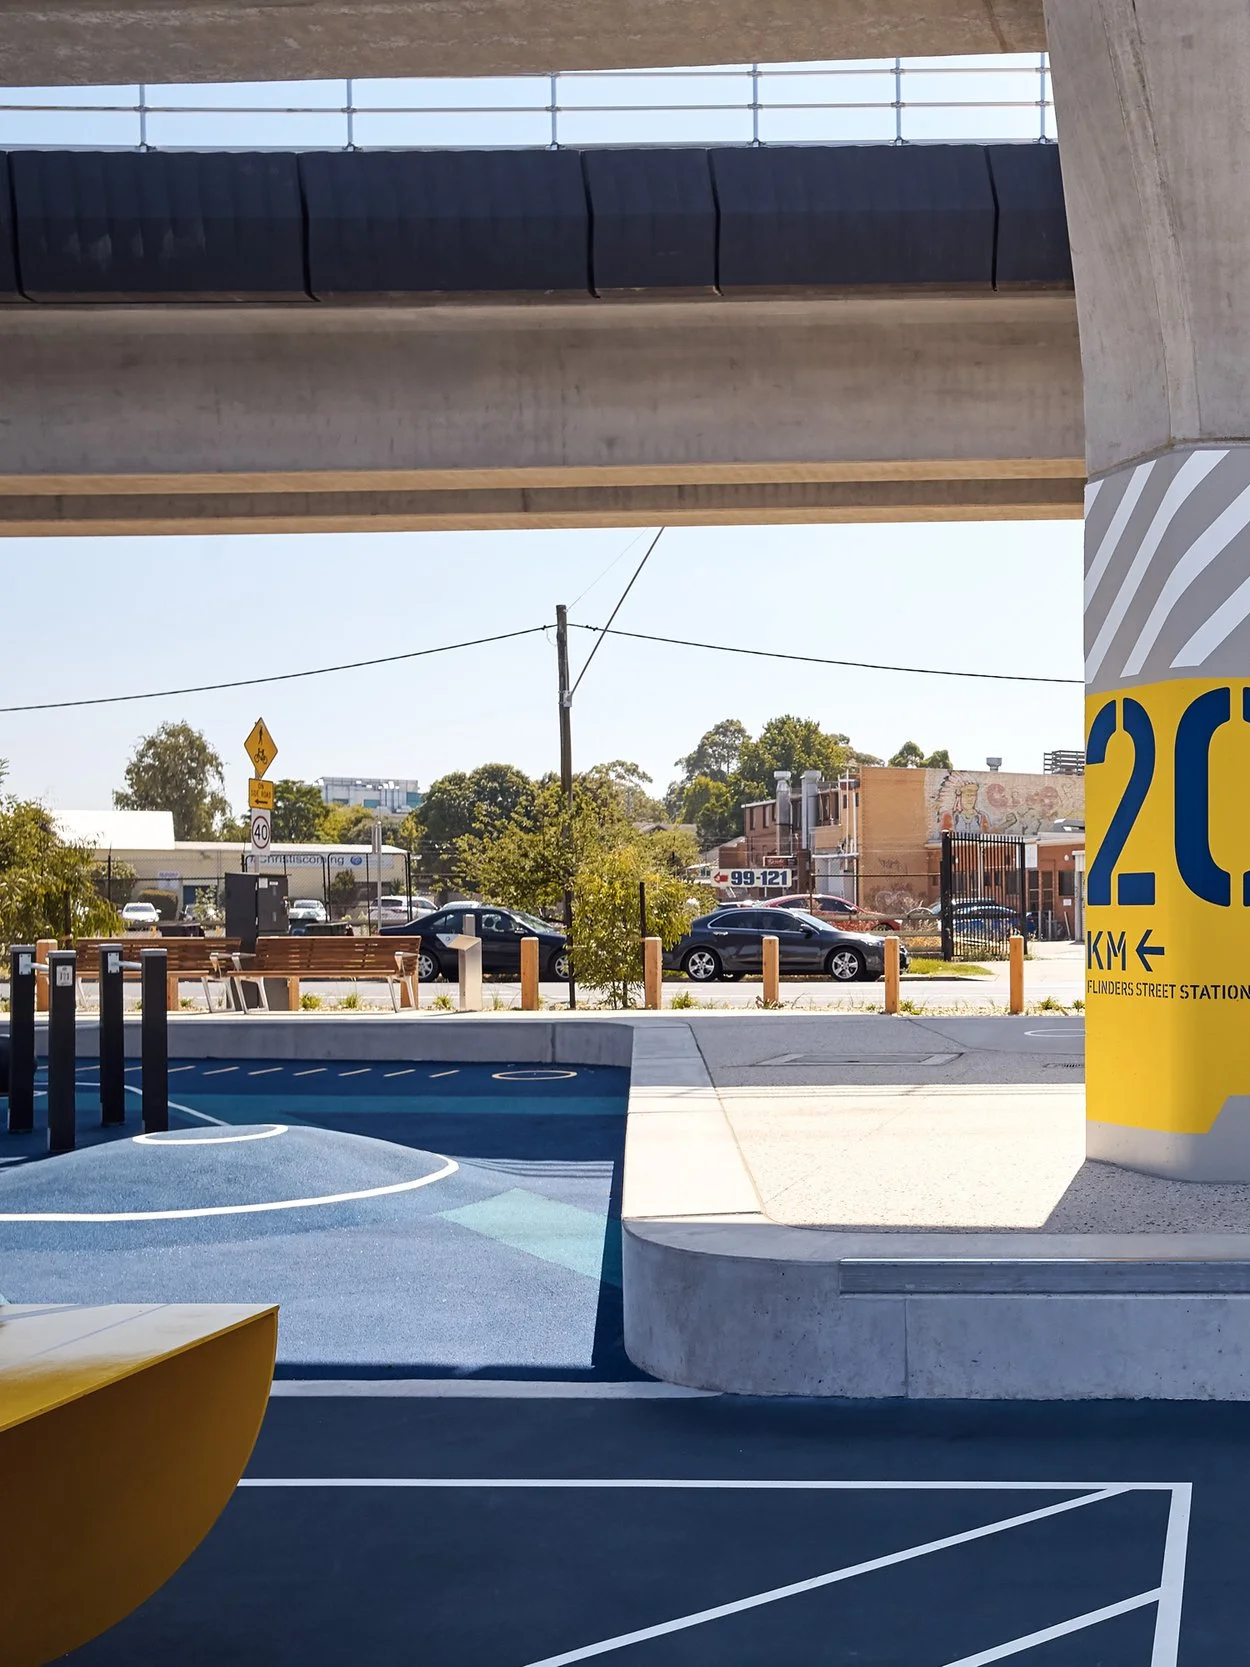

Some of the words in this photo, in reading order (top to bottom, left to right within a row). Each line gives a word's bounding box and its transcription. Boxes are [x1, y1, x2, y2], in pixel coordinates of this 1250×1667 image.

[254, 824, 268, 841] 40
[731, 870, 787, 886] 99-121
[1087, 930, 1127, 971] KM
[1087, 980, 1134, 996] FLINDERS
[1136, 982, 1177, 999] STREET
